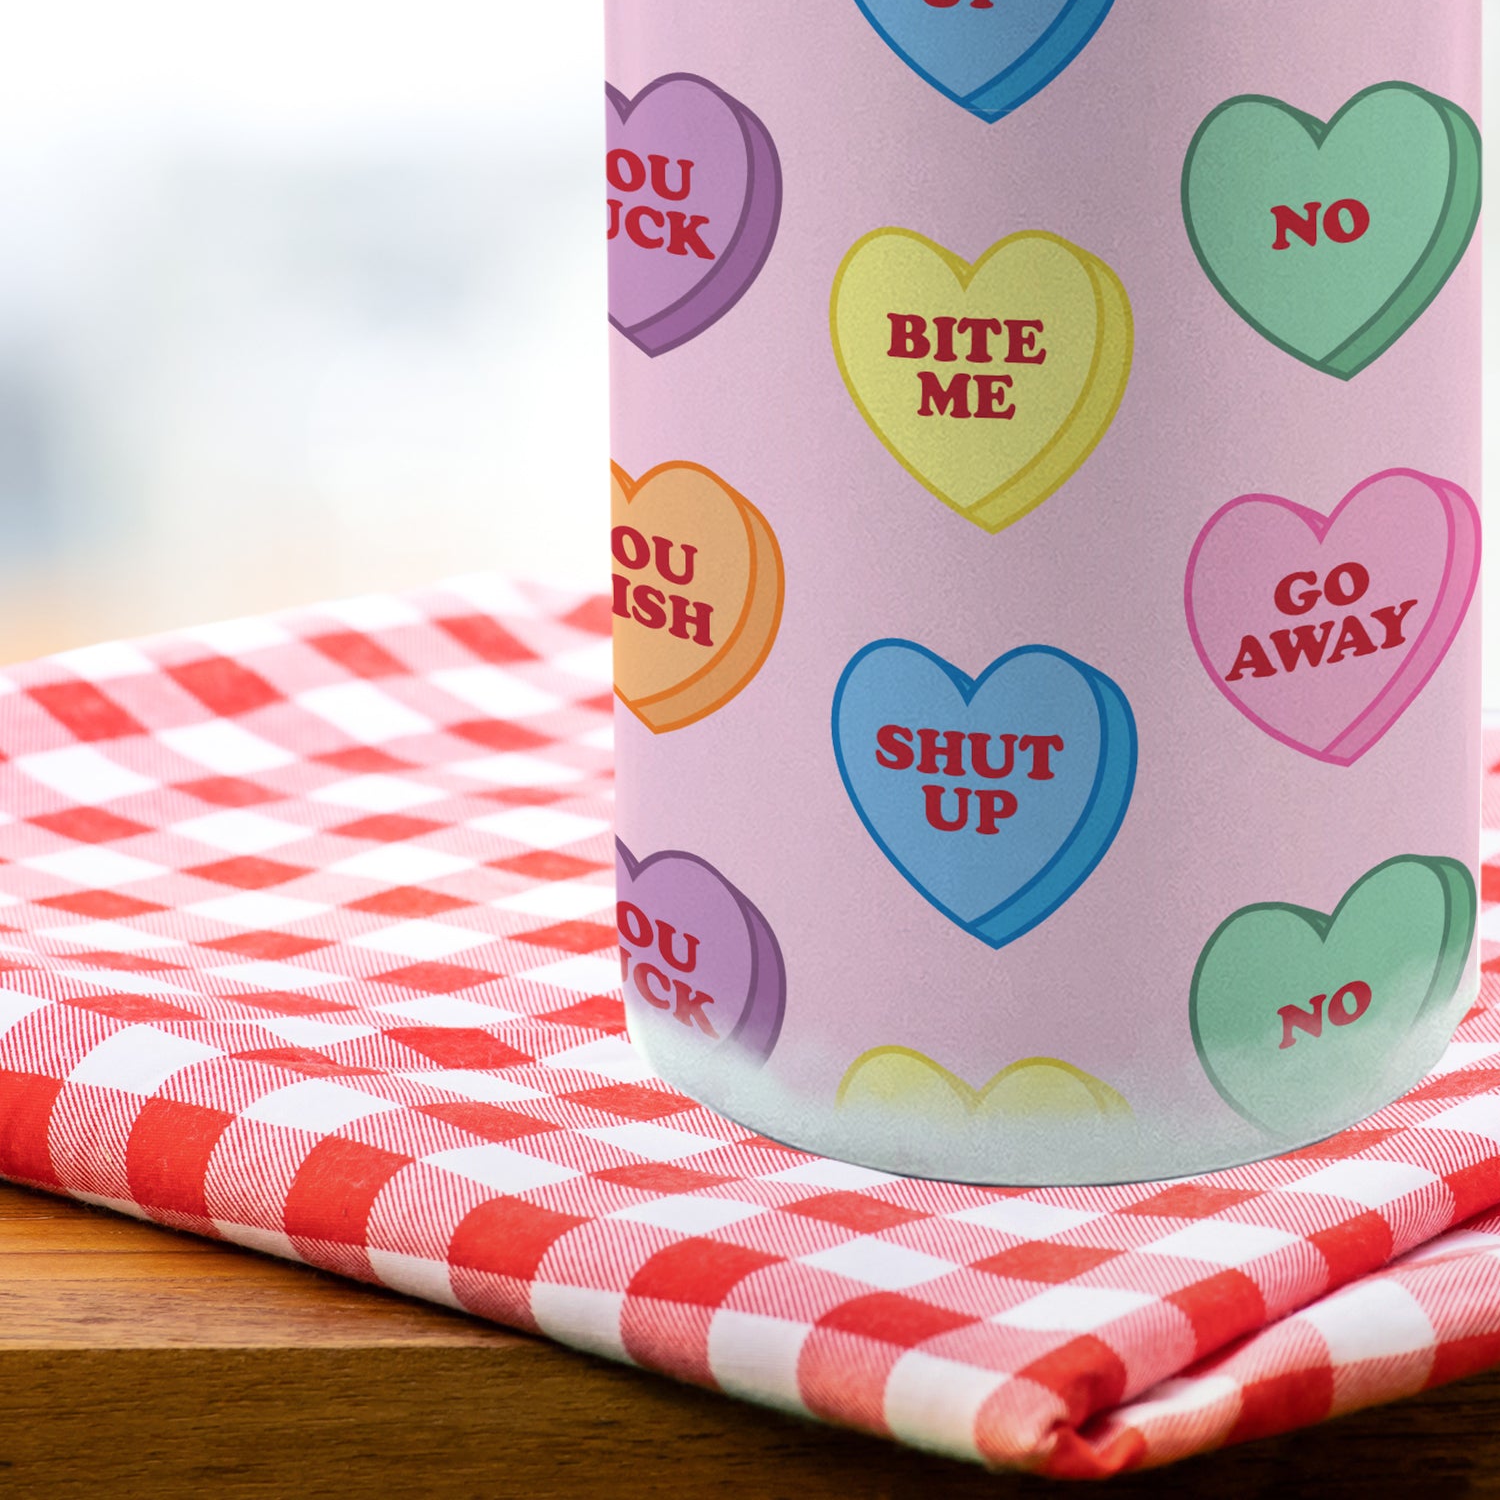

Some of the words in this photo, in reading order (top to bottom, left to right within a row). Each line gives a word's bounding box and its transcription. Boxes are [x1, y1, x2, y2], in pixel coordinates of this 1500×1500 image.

[1271, 198, 1370, 250] NO
[887, 312, 1046, 365] BITE
[917, 371, 1016, 420] ME
[1273, 561, 1370, 616] GO
[1224, 599, 1418, 682] AWAY
[875, 725, 1064, 780] SHUT
[922, 785, 1017, 835] UP
[1277, 980, 1372, 1049] NO
